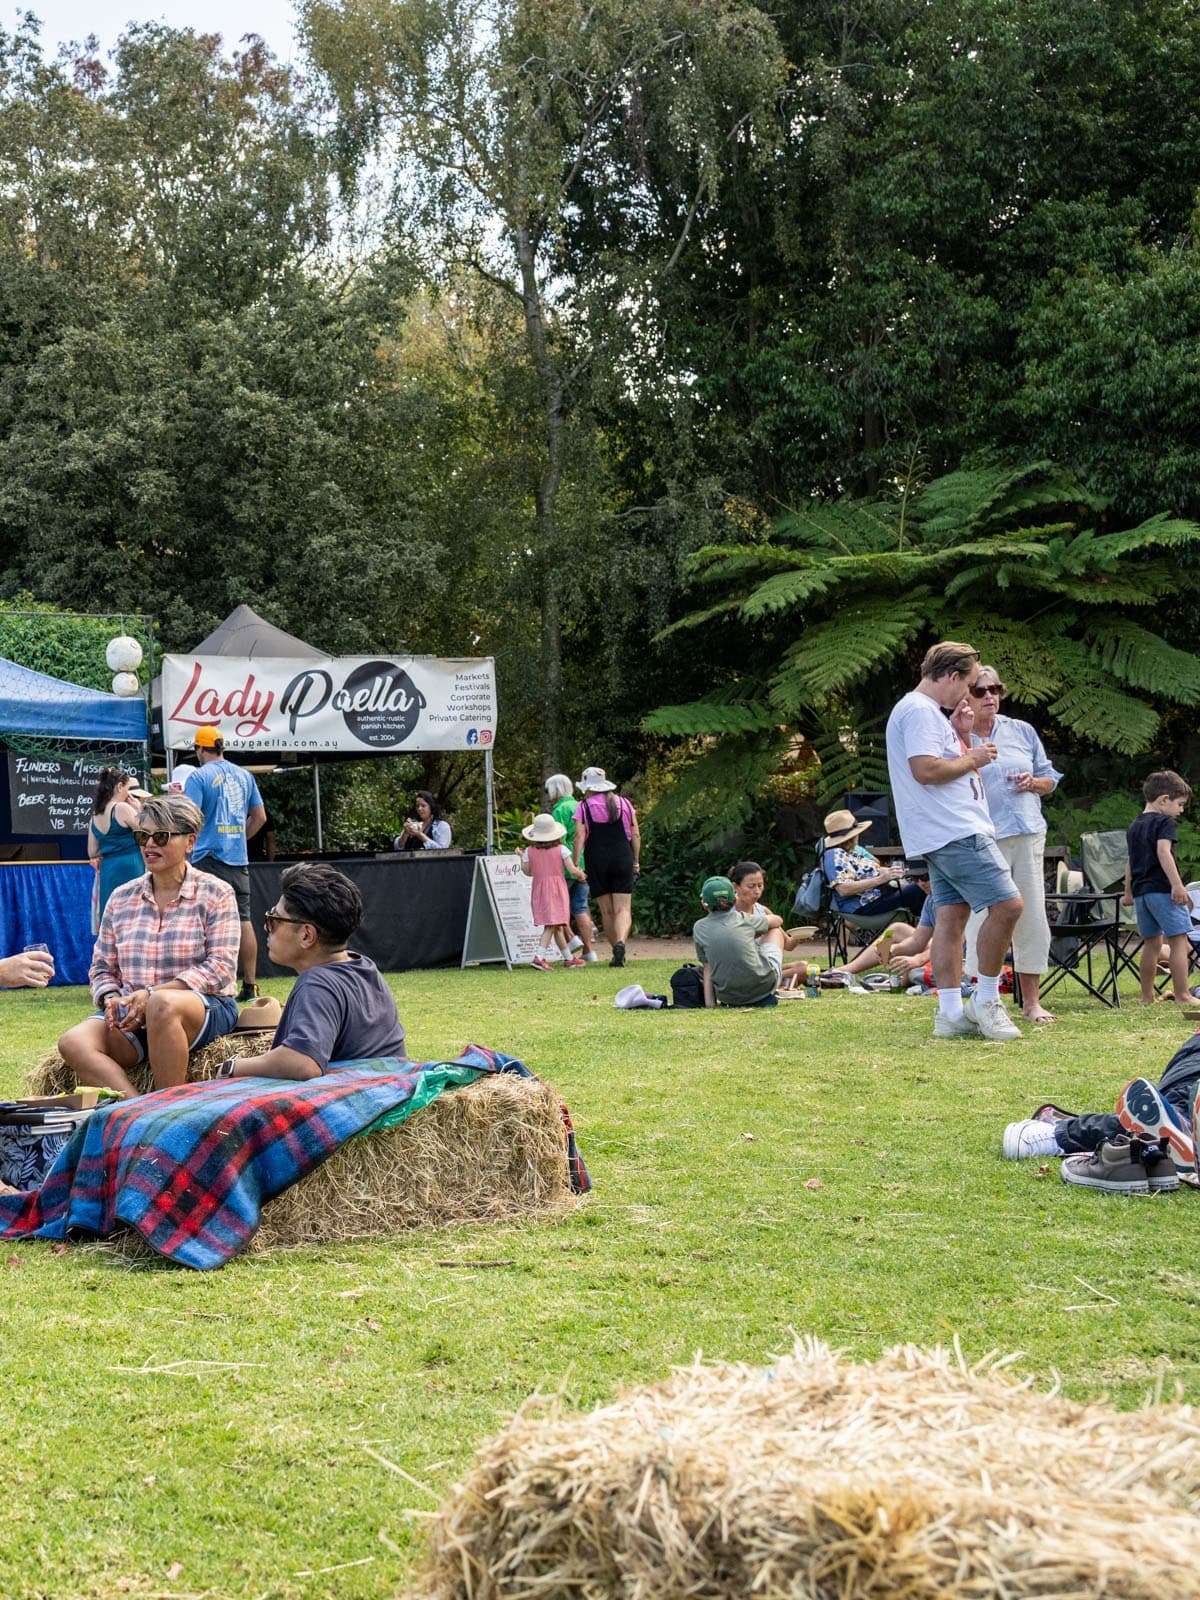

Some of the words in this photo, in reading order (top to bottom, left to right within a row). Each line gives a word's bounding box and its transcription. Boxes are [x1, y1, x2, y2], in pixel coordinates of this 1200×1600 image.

[456, 673, 490, 681] Markets
[454, 682, 490, 691] Festivals
[167, 661, 275, 738] Lady
[280, 669, 415, 736] Paella
[450, 694, 491, 703] Corporate
[446, 704, 491, 713] Workshops
[429, 714, 458, 722] Private
[460, 714, 492, 723] Catering
[15, 757, 60, 774] FLINDERS
[73, 757, 104, 777] MUSSE
[50, 818, 65, 830] VB
